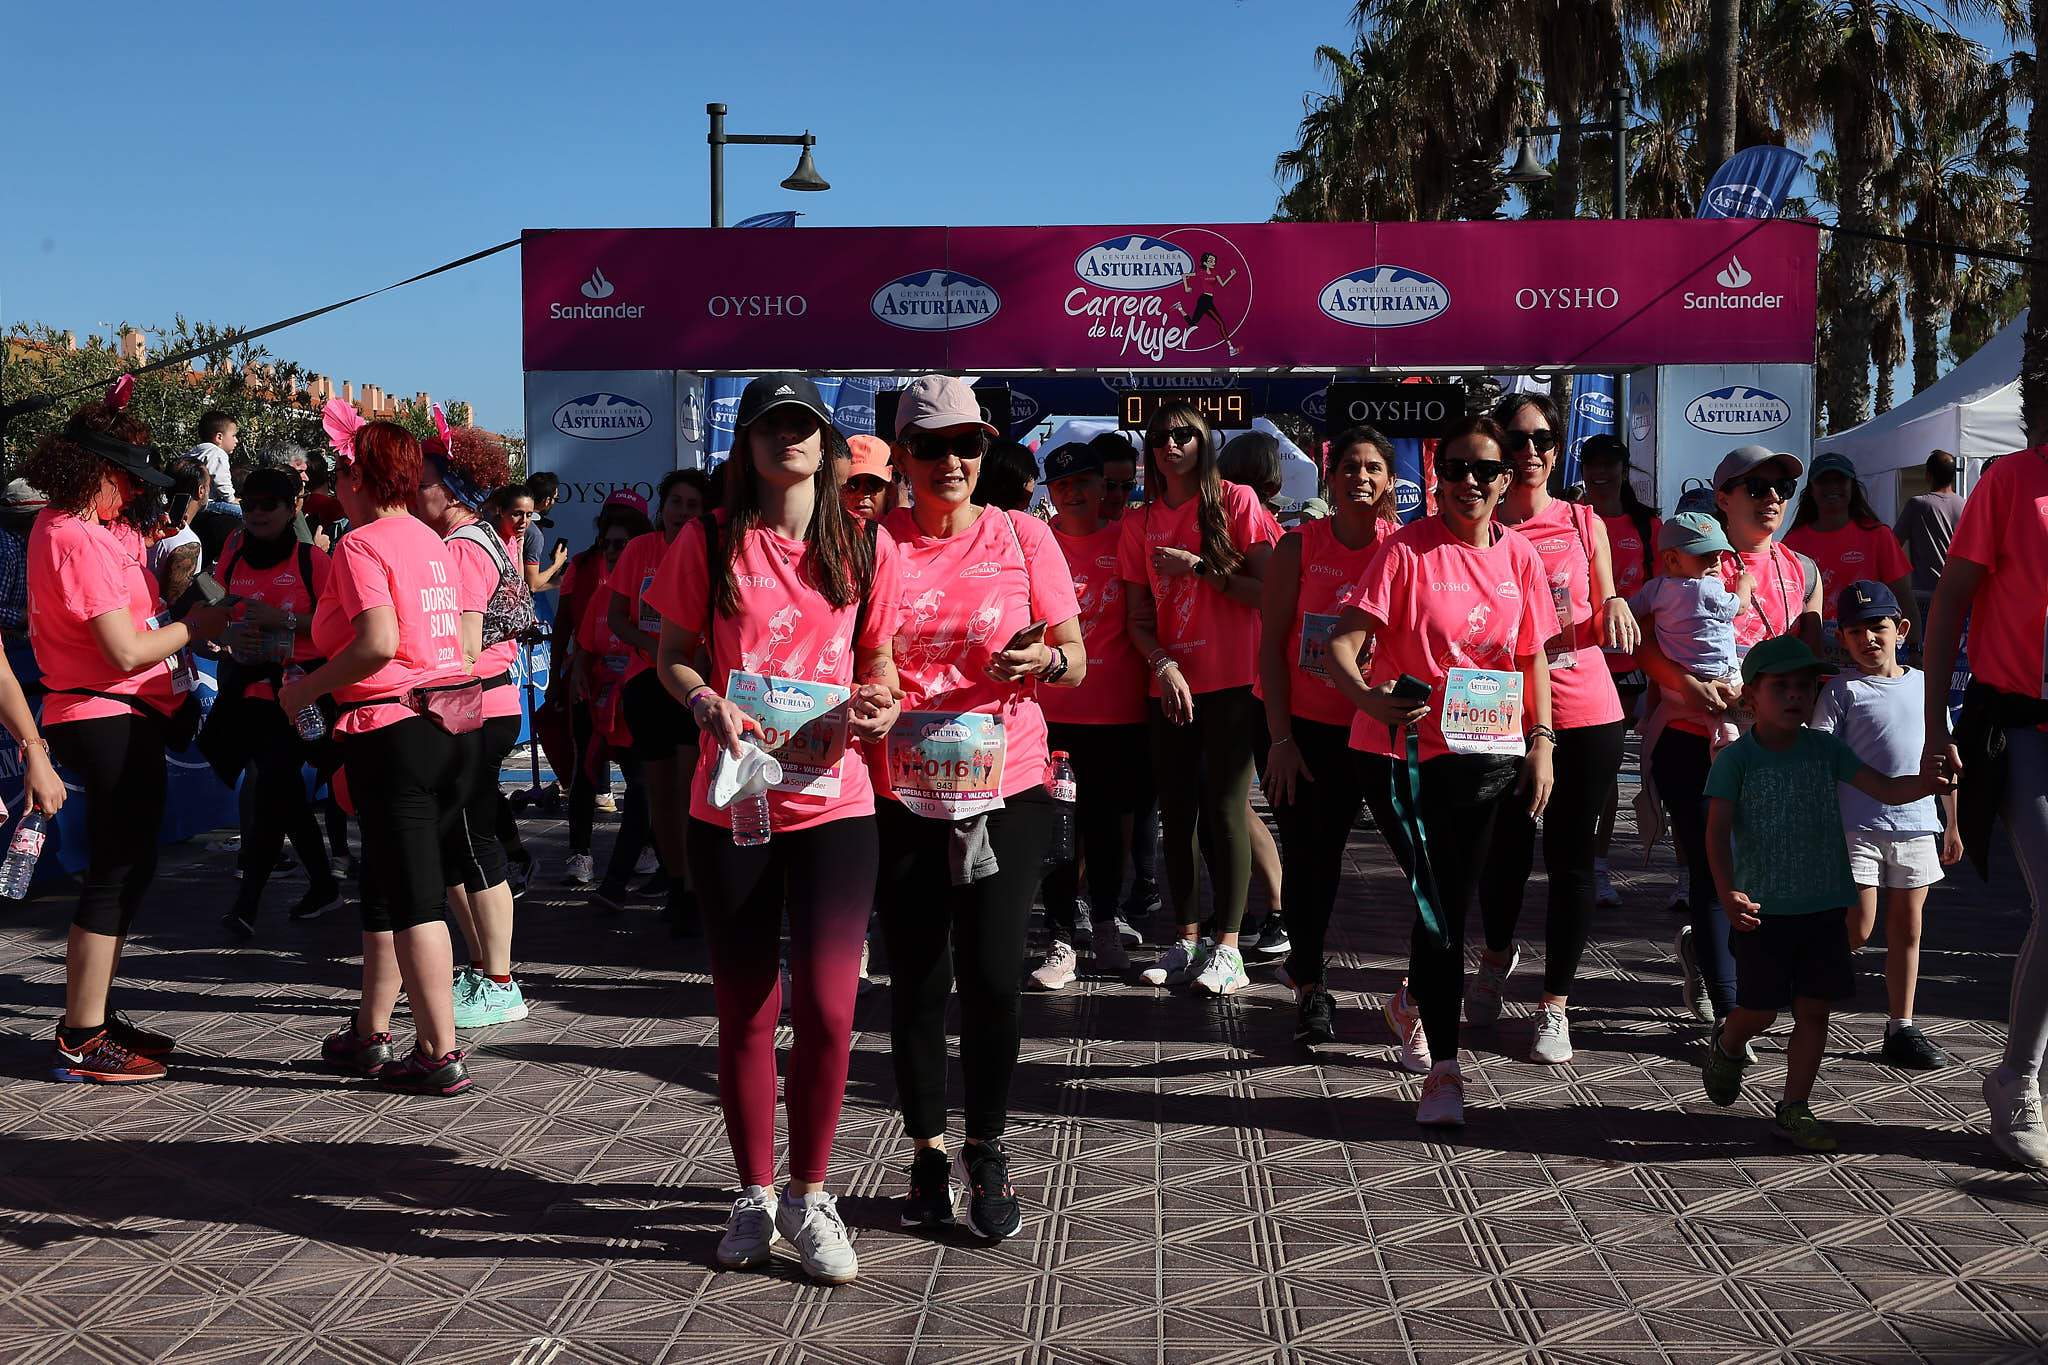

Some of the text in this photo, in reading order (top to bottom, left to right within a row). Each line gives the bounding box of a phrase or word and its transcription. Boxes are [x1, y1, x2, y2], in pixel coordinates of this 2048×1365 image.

[1084, 256, 1184, 276] ASTURIANA
[708, 295, 807, 317] OYSHO
[881, 293, 990, 315] ASTURIANA
[1065, 288, 1163, 317] Carrera
[1329, 289, 1440, 311] ASTURIANA
[1515, 287, 1619, 309] OYSHO
[1683, 292, 1784, 309] Santander
[550, 303, 646, 320] Santander
[1088, 318, 1124, 337] de la
[1120, 314, 1199, 361] Mujer
[560, 411, 645, 429] ASTURIANA
[1348, 400, 1446, 421] OYSHO
[1692, 404, 1783, 423] ASTURIANA
[429, 561, 447, 585] TU
[1432, 582, 1470, 592] OYSHO
[767, 695, 812, 709] ASTURIANA
[1469, 708, 1498, 724] 016
[764, 727, 807, 752] 016
[924, 728, 968, 738] ASTURIANA
[925, 760, 970, 778] 016
[936, 781, 954, 791] 943
